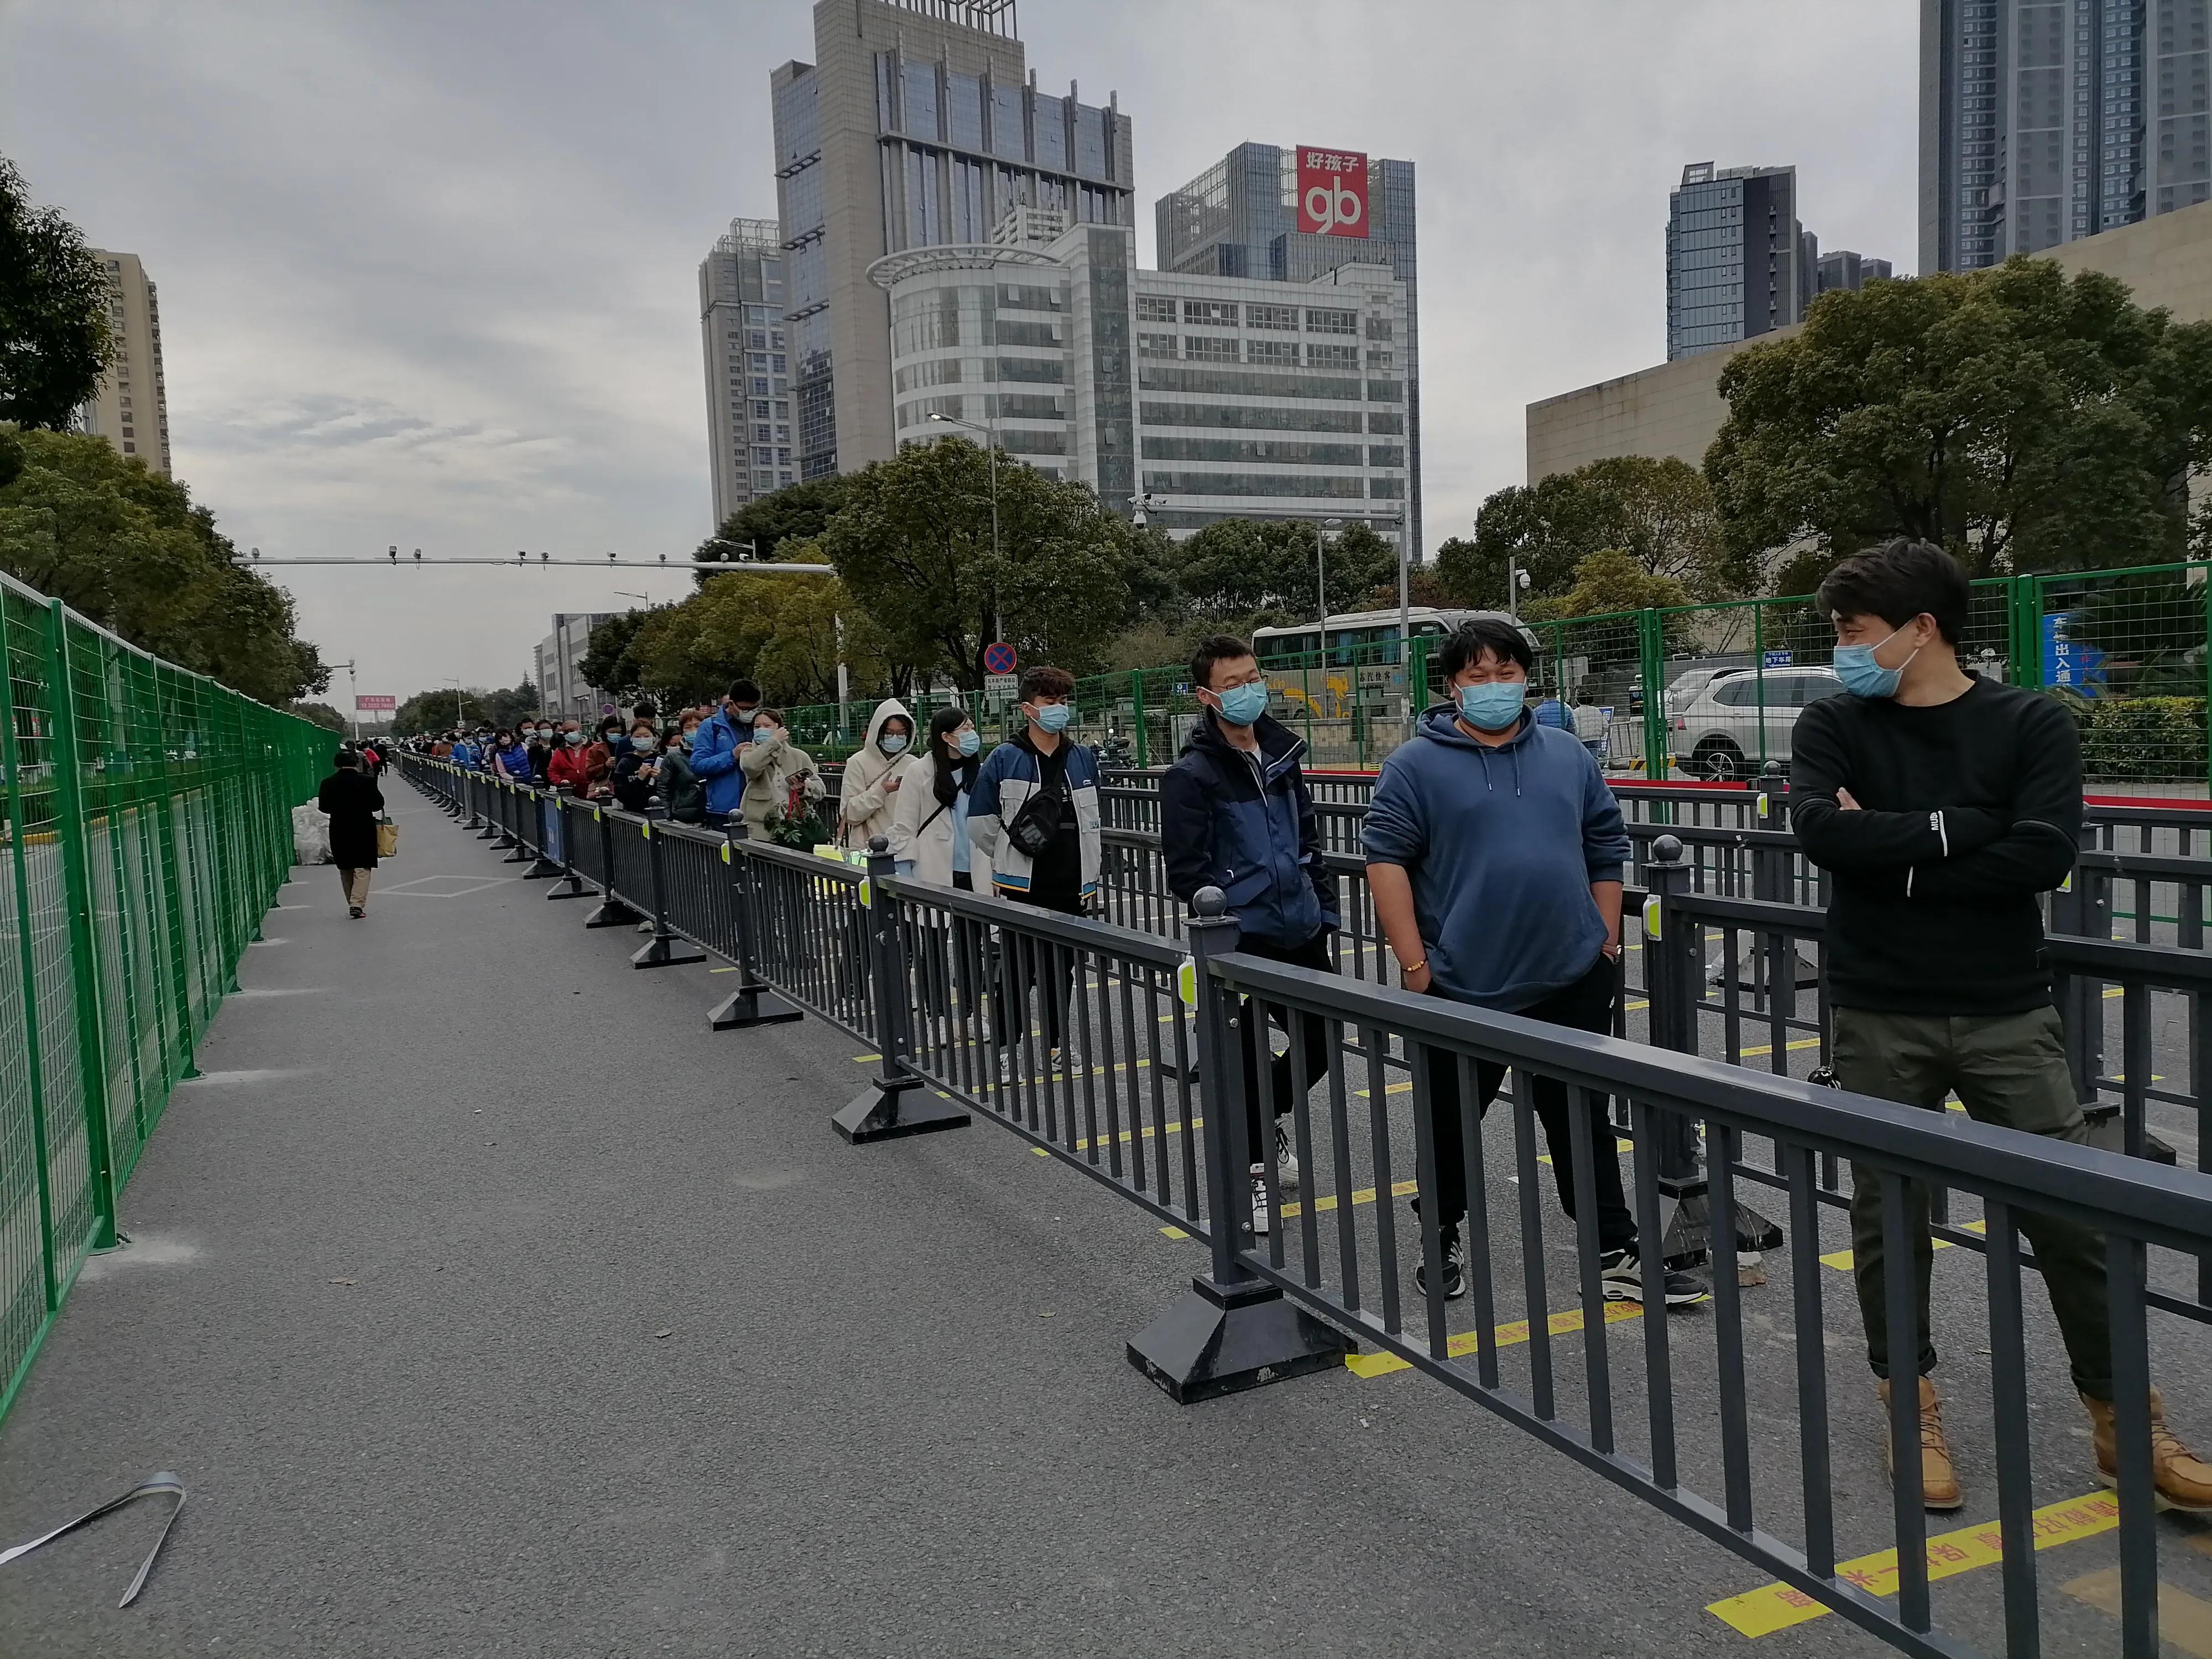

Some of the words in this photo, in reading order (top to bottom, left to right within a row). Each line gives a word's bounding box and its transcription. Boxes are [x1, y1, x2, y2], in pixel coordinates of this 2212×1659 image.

[1306, 152, 1359, 173] 好孩子
[1305, 175, 1361, 234] gb
[1359, 670, 1390, 682] 苏汽快客
